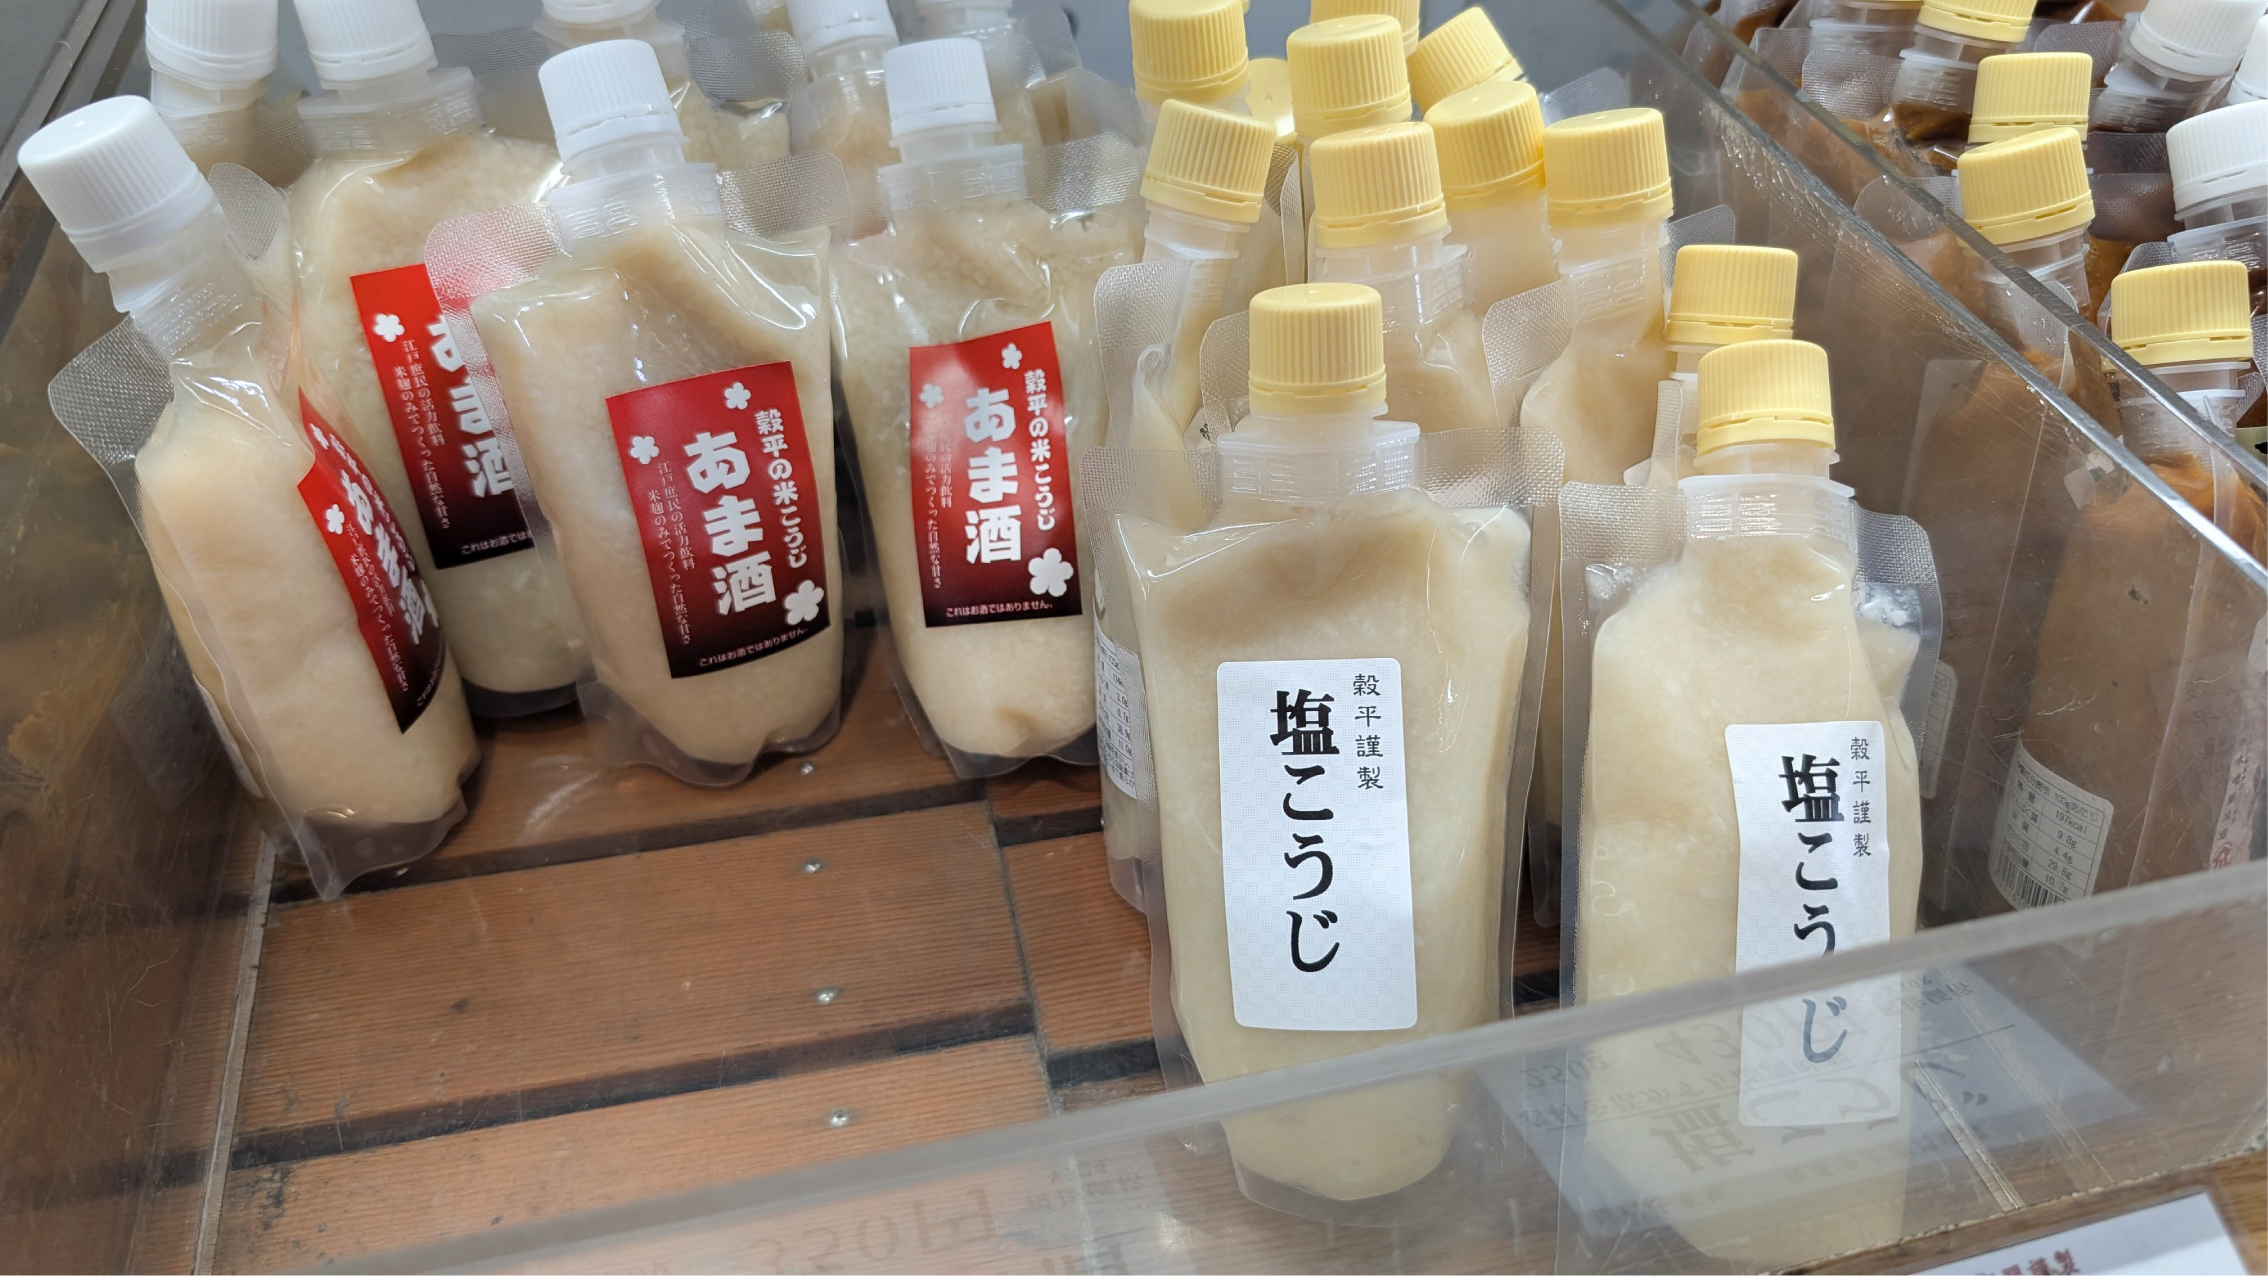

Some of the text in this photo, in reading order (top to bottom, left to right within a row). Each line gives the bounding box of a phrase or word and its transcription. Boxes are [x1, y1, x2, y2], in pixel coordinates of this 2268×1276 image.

[657, 461, 697, 570] 江戸庶民の活力飲料
[684, 430, 777, 617] あま酒
[755, 408, 808, 569] 穀平の米こうじ
[964, 387, 1023, 565] あま酒
[1024, 367, 1056, 532] 穀平の米こうじ
[341, 468, 426, 646] あま酒
[946, 598, 1054, 618] これはお酒ではありません。
[1352, 673, 1385, 790] 穀平謹製
[1850, 736, 1873, 857] 穀平謹製
[1269, 688, 1340, 973] 塩こうじ
[1778, 752, 1848, 1065] 塩こうじ
